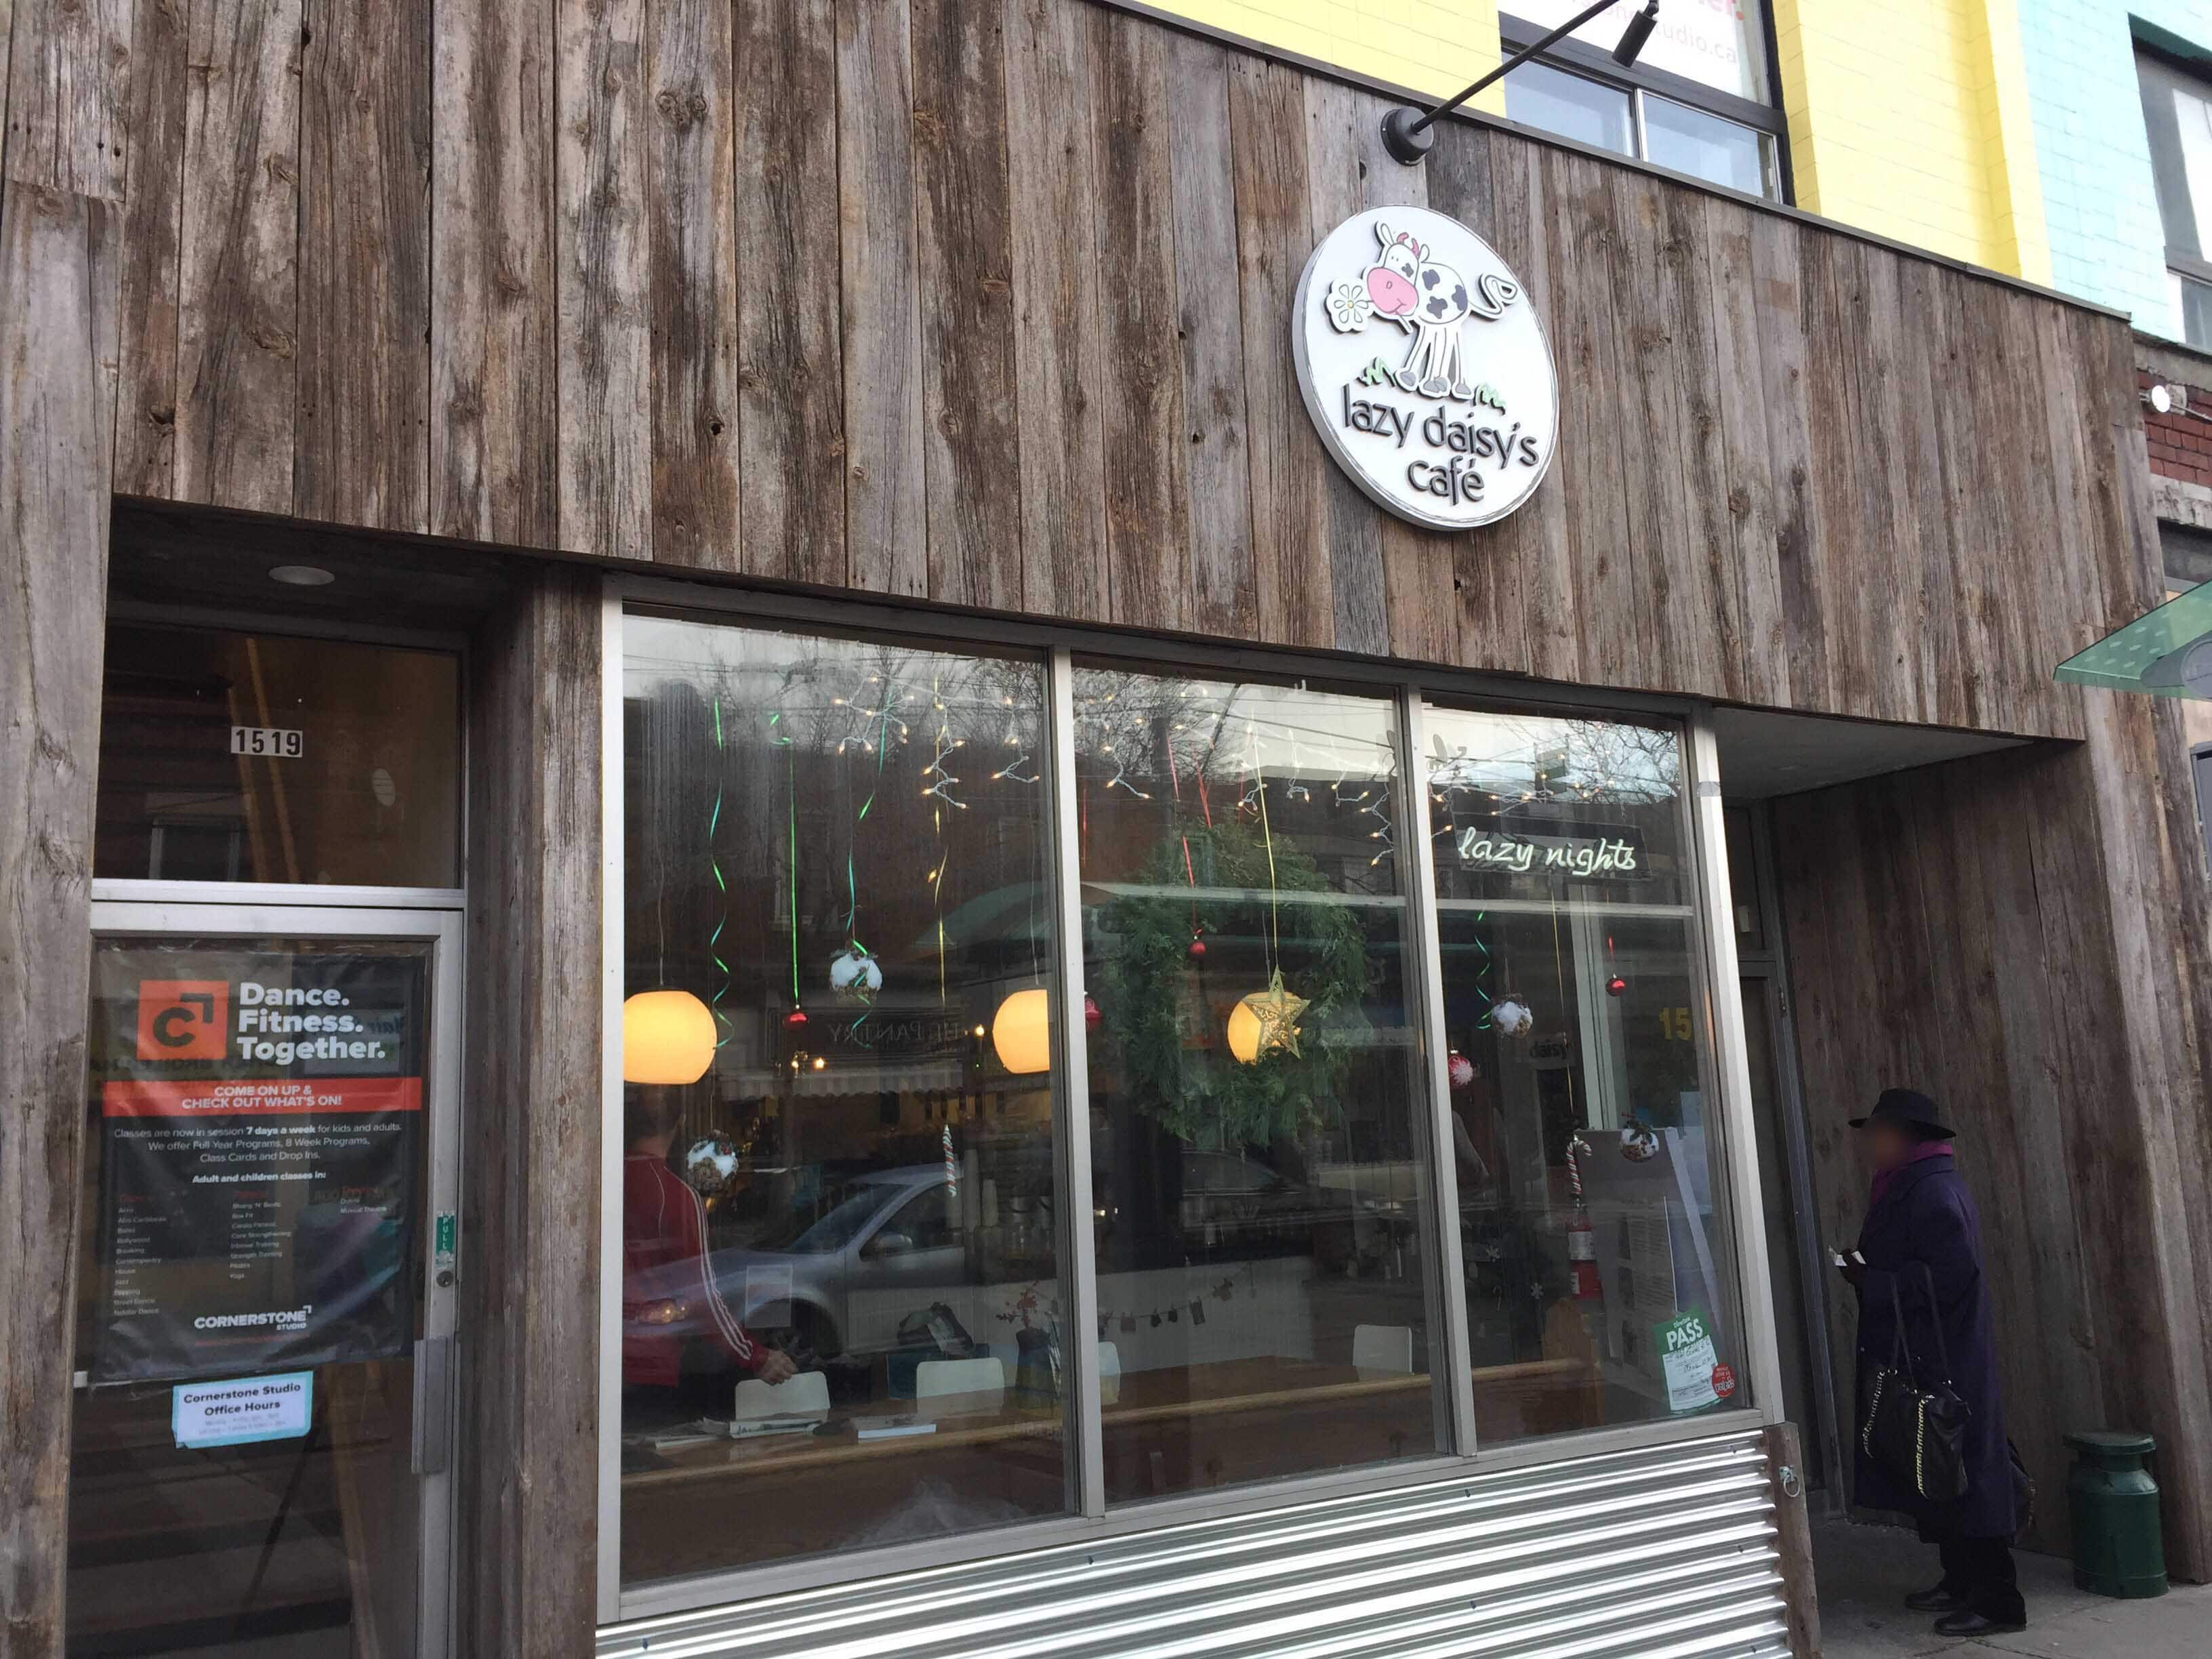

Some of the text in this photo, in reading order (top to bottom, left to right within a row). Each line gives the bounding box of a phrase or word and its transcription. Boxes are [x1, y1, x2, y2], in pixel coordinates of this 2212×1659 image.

[1342, 382, 1539, 468] lazy daisy's
[1407, 456, 1485, 506] café
[236, 729, 300, 756] 1519
[1458, 826, 1637, 876] lazy nights
[240, 982, 350, 1006] Dance.
[238, 1008, 364, 1033] Fitness.
[237, 1036, 386, 1065] Together.
[182, 1095, 342, 1109] CHECK OUT WHAT'S ON!
[214, 1086, 312, 1097] COME ON UP &
[114, 1128, 152, 1139] Classes
[173, 1129, 194, 1137] now
[196, 1128, 205, 1136] in
[207, 1127, 244, 1136] session
[246, 1126, 253, 1134] 7
[254, 1126, 278, 1136] days
[289, 1126, 315, 1134] week
[318, 1125, 330, 1133] for
[333, 1124, 351, 1132] kids
[353, 1124, 371, 1132] and
[148, 1142, 164, 1151] We
[167, 1141, 190, 1150] offer
[192, 1141, 209, 1149] Full
[212, 1141, 232, 1149] Year
[294, 1138, 322, 1147] Week
[200, 1153, 226, 1162] Class
[228, 1153, 257, 1162] Cards
[259, 1152, 277, 1161] and
[279, 1152, 303, 1162] Drop
[192, 1174, 219, 1183] Adult
[221, 1174, 239, 1182] and
[241, 1172, 279, 1182] children
[280, 1172, 312, 1180] classes
[194, 1310, 307, 1330] CORNERSTONE
[1666, 1318, 1703, 1351] PASS
[184, 1382, 301, 1404] Cornerstone Studio
[204, 1400, 281, 1416] Office Hours
